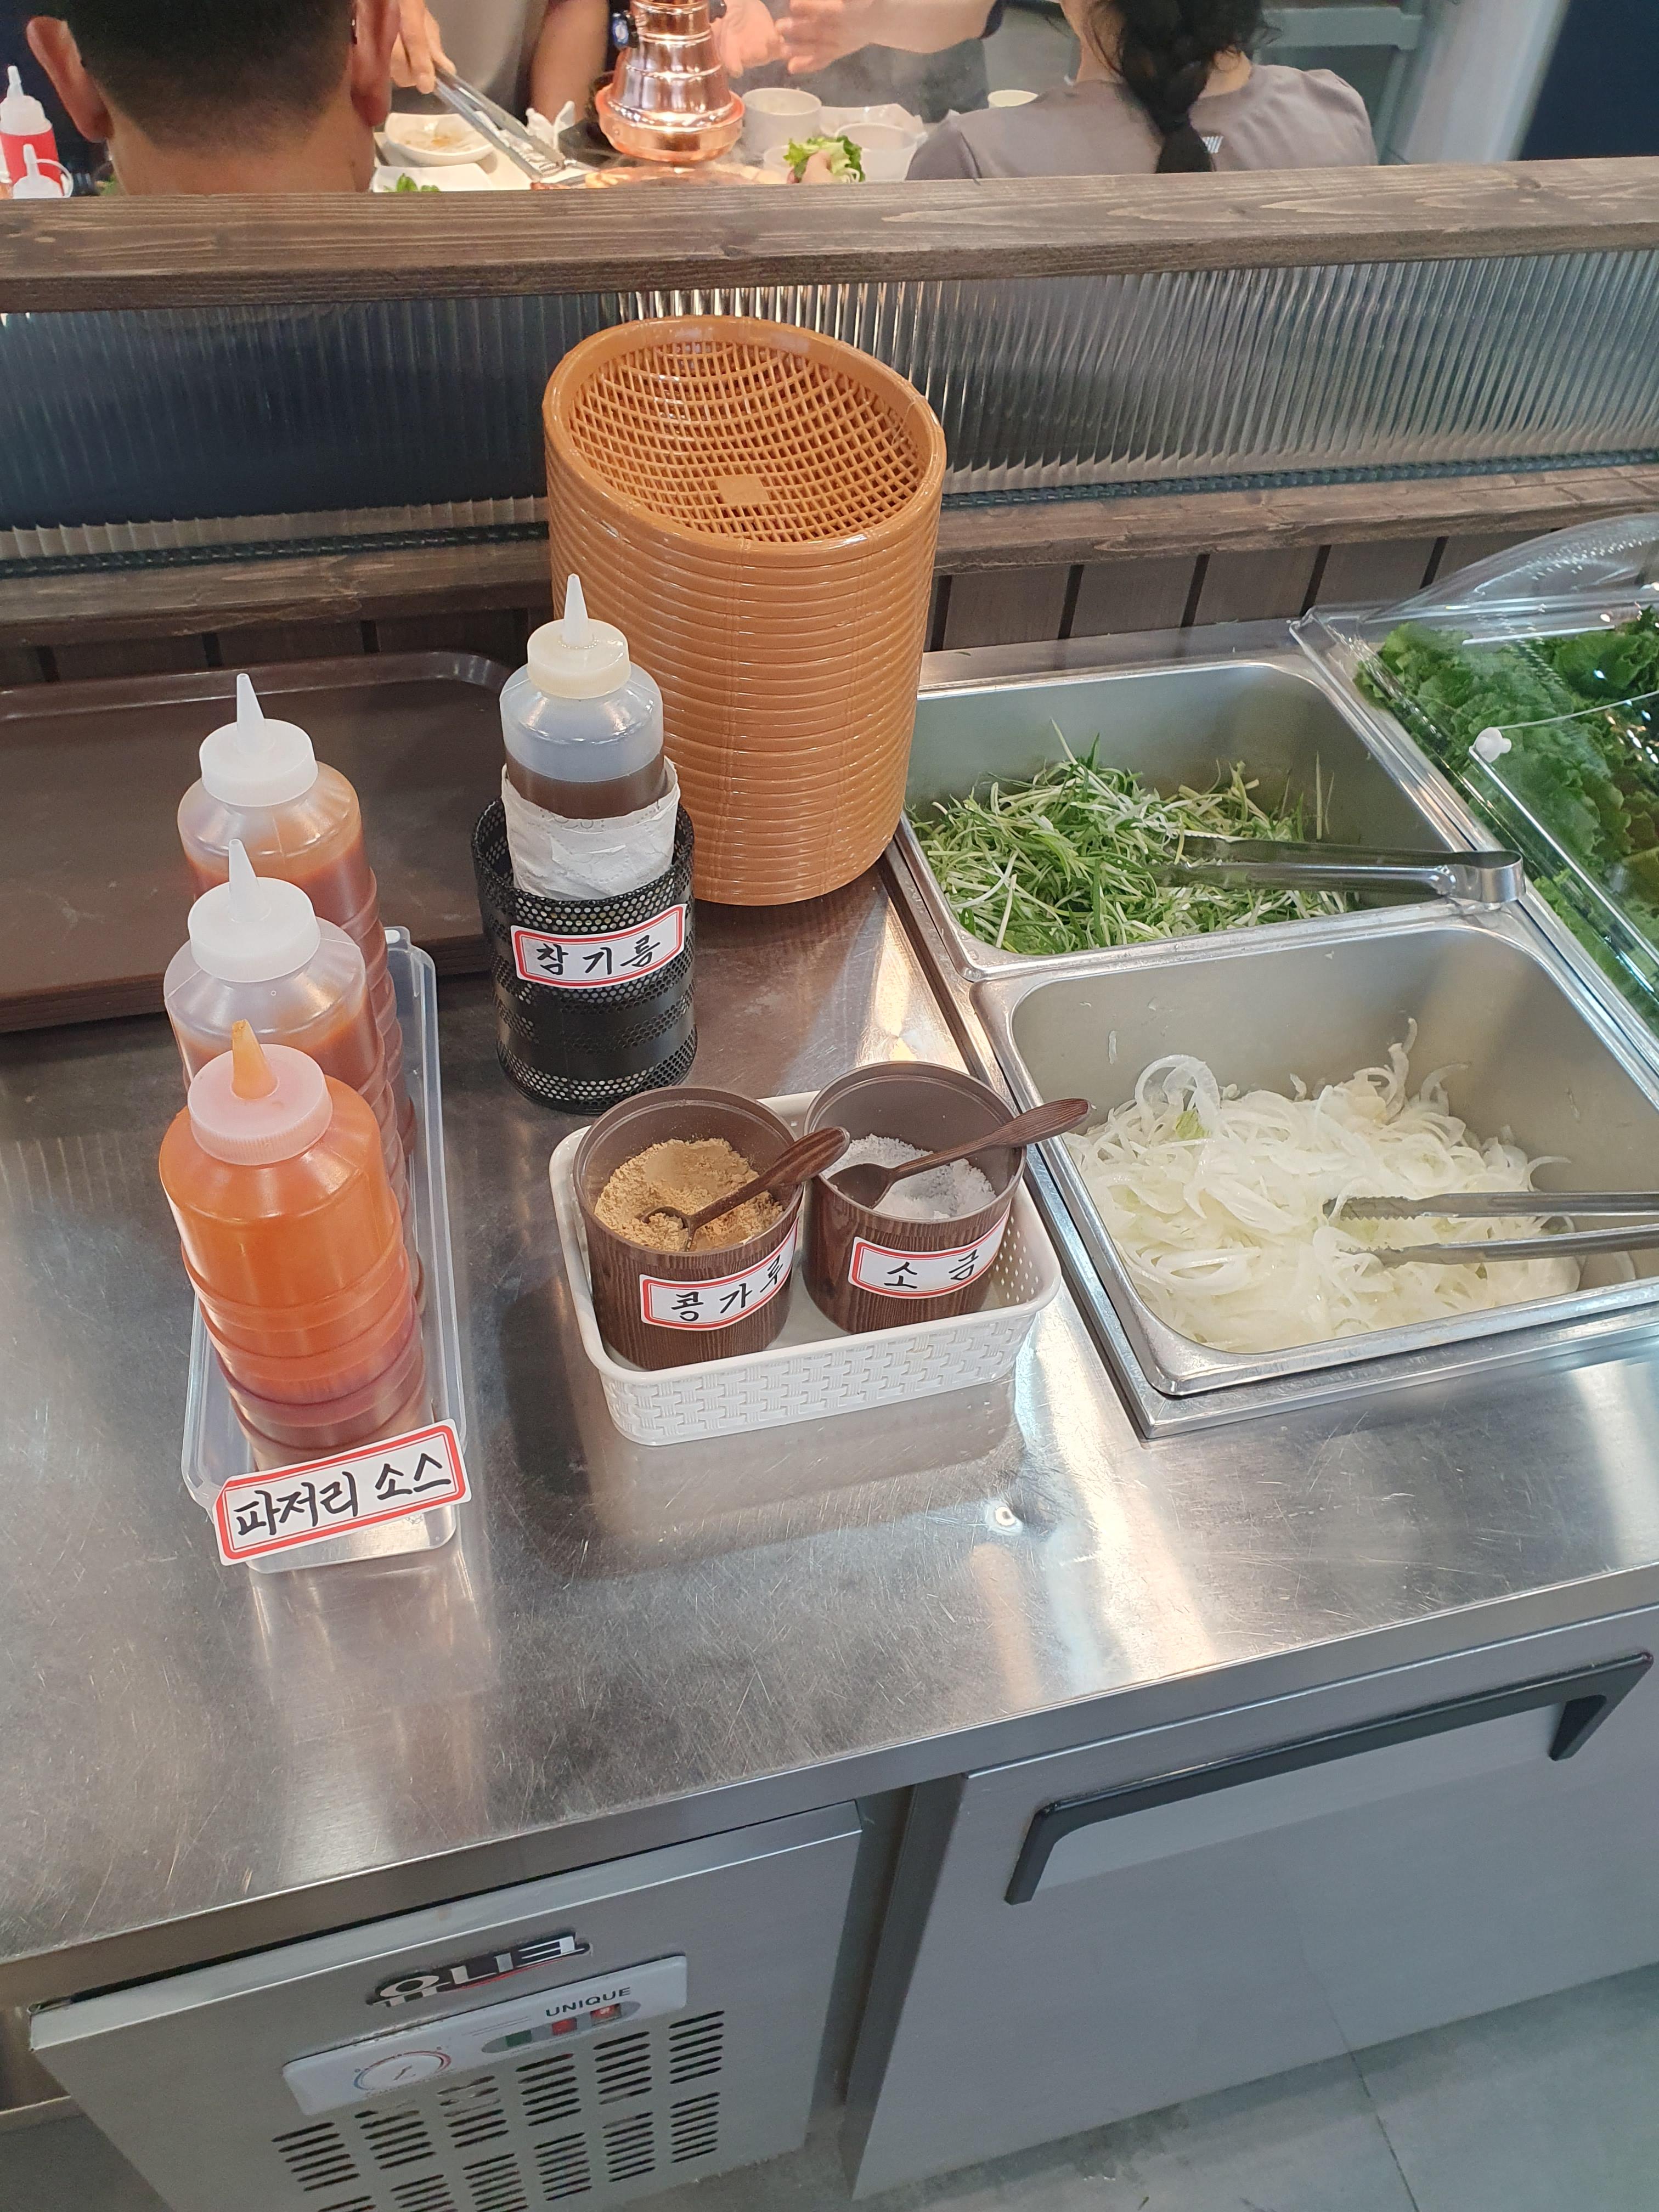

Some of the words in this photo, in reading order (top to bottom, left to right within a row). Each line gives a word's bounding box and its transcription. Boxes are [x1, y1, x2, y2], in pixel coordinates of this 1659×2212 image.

[536, 935, 661, 975] 참기름
[671, 1254, 783, 1322] 콩가루
[884, 1249, 979, 1289] 소금
[233, 1471, 359, 1536] 파저리
[375, 1453, 452, 1500] 소스
[545, 1987, 631, 2017] UNIQUE
